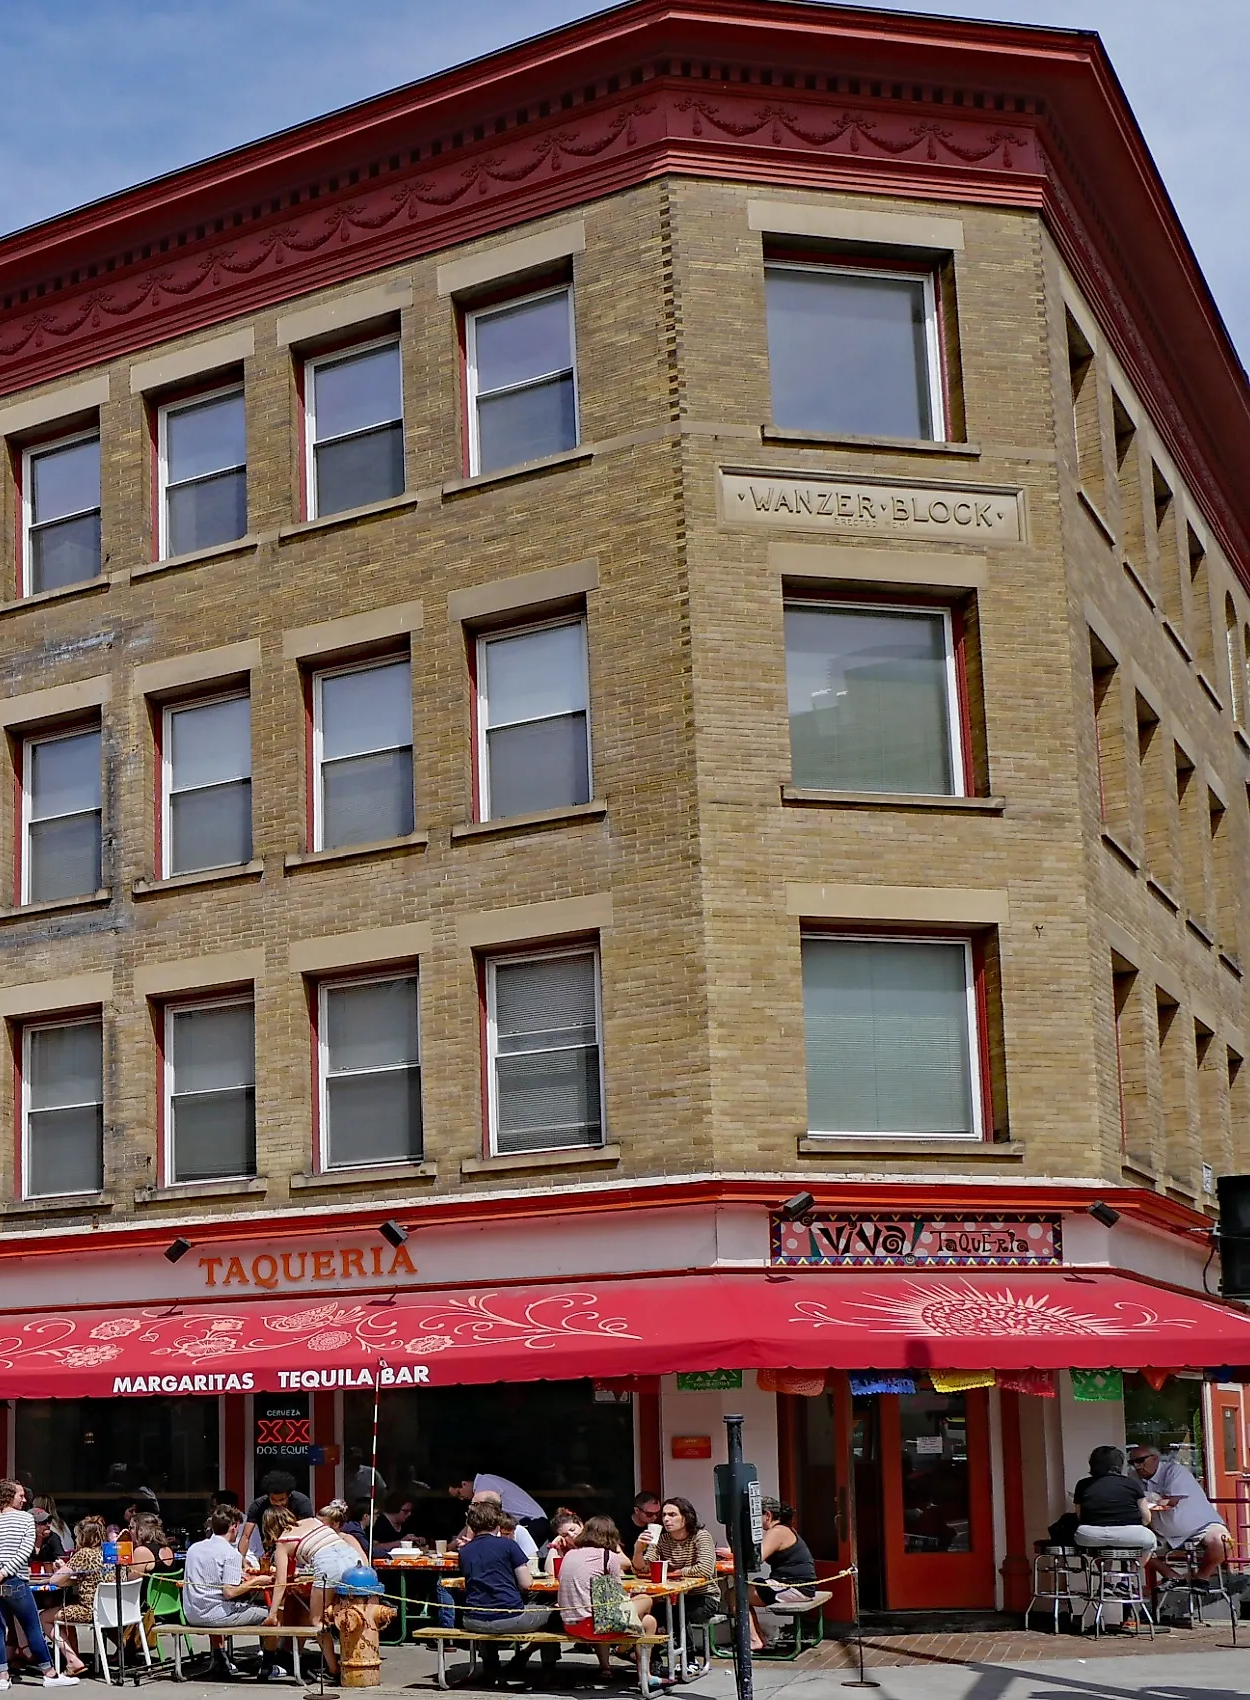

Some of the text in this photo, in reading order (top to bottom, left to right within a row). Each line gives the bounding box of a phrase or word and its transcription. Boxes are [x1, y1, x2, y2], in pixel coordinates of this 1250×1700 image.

[749, 486, 993, 528] WANZER BLOCK
[198, 1245, 418, 1289] TAQUERIA
[112, 1365, 430, 1393] MARGARITAS TEQUILA BAR
[266, 1409, 302, 1417] CERVEZA
[257, 1419, 311, 1443] XX
[256, 1445, 310, 1455] DOS EQUIS
